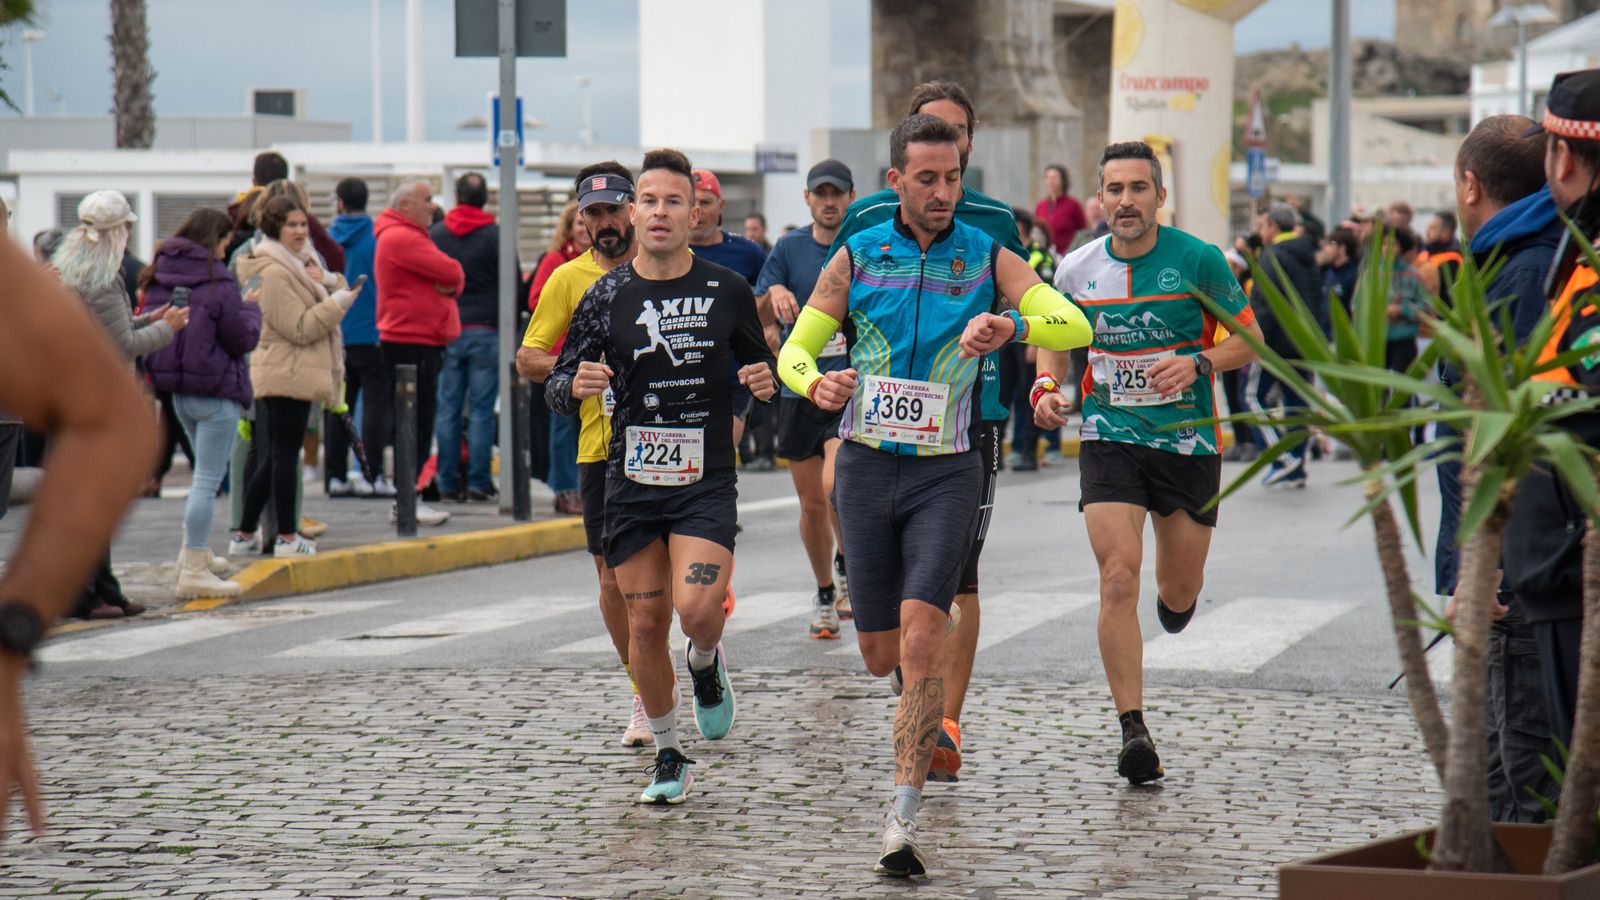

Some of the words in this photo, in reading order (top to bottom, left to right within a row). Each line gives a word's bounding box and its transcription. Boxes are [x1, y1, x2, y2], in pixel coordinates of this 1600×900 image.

[1120, 73, 1210, 93] Cruzcampo
[661, 297, 715, 317] XIV
[660, 315, 704, 325] CARRERA
[660, 321, 708, 331] ESTRECHO
[670, 336, 695, 344] PEPE
[671, 341, 715, 350] SERRANO
[1116, 359, 1135, 369] XIV
[649, 377, 705, 389] metrovacesa
[877, 381, 902, 394] XIV
[902, 384, 930, 392] CARRERA
[914, 392, 944, 400] ESTRECHO
[881, 394, 923, 422] 369
[638, 431, 661, 443] XIV
[643, 443, 683, 466] 224
[685, 562, 722, 586] 35
